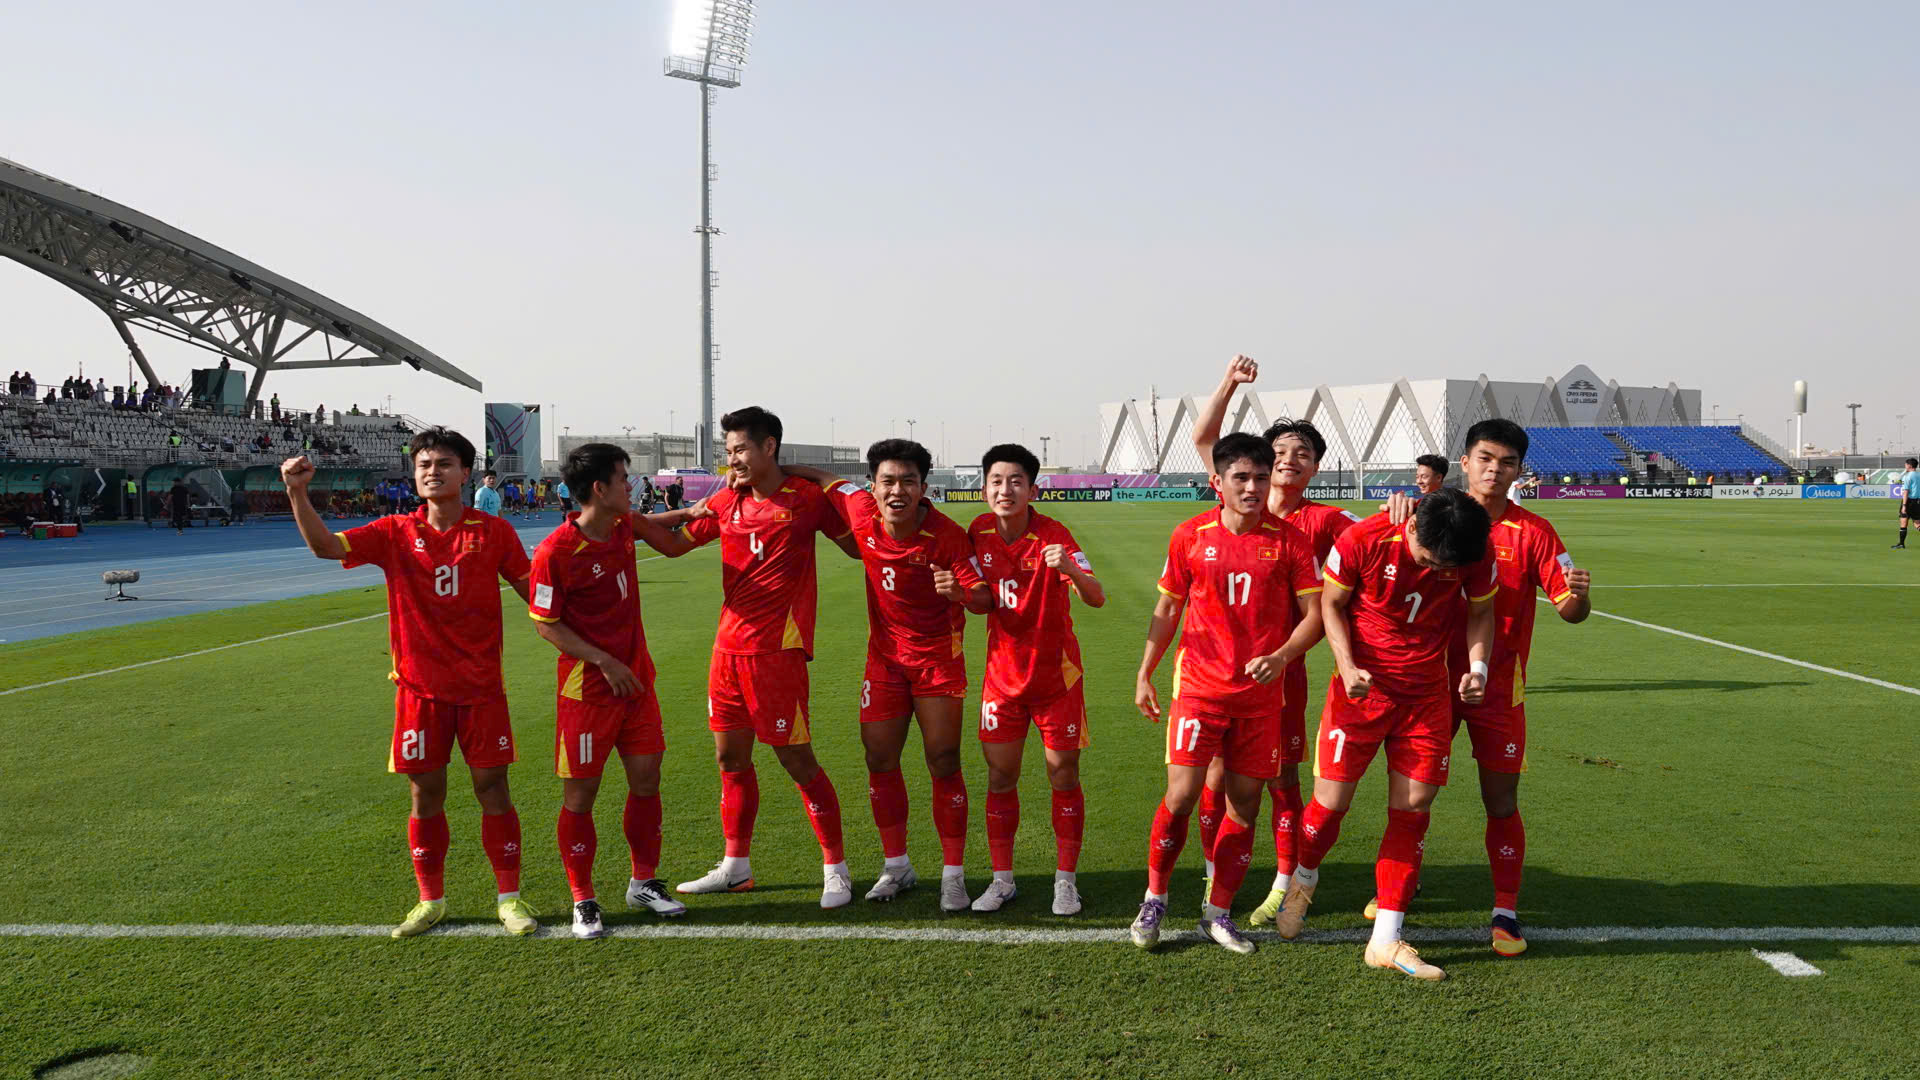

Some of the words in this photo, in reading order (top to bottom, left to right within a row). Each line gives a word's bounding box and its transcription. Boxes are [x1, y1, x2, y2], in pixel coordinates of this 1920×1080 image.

[947, 491, 984, 501] DOWNLOA
[1041, 491, 1066, 500] AFC
[1067, 491, 1093, 500] LIVE
[1095, 490, 1110, 500] APP
[1368, 488, 1393, 498] VISA
[1556, 487, 1586, 498] Saudi
[1626, 489, 1672, 497] KELME
[1684, 488, 1712, 497] 卡尔美
[1769, 487, 1793, 496] نيوم
[1813, 488, 1841, 497] Midea
[1858, 488, 1886, 497] Midea
[750, 532, 764, 561] 4
[435, 565, 458, 597] 21
[882, 566, 895, 591] 3
[1228, 572, 1251, 606] 17
[999, 578, 1018, 609] 16
[1405, 591, 1422, 623] 7
[861, 679, 871, 709] 3
[982, 701, 997, 730] 16
[402, 729, 425, 761] 21
[580, 732, 592, 765] 11
[1175, 717, 1201, 752] 17
[1328, 728, 1346, 763] 7
